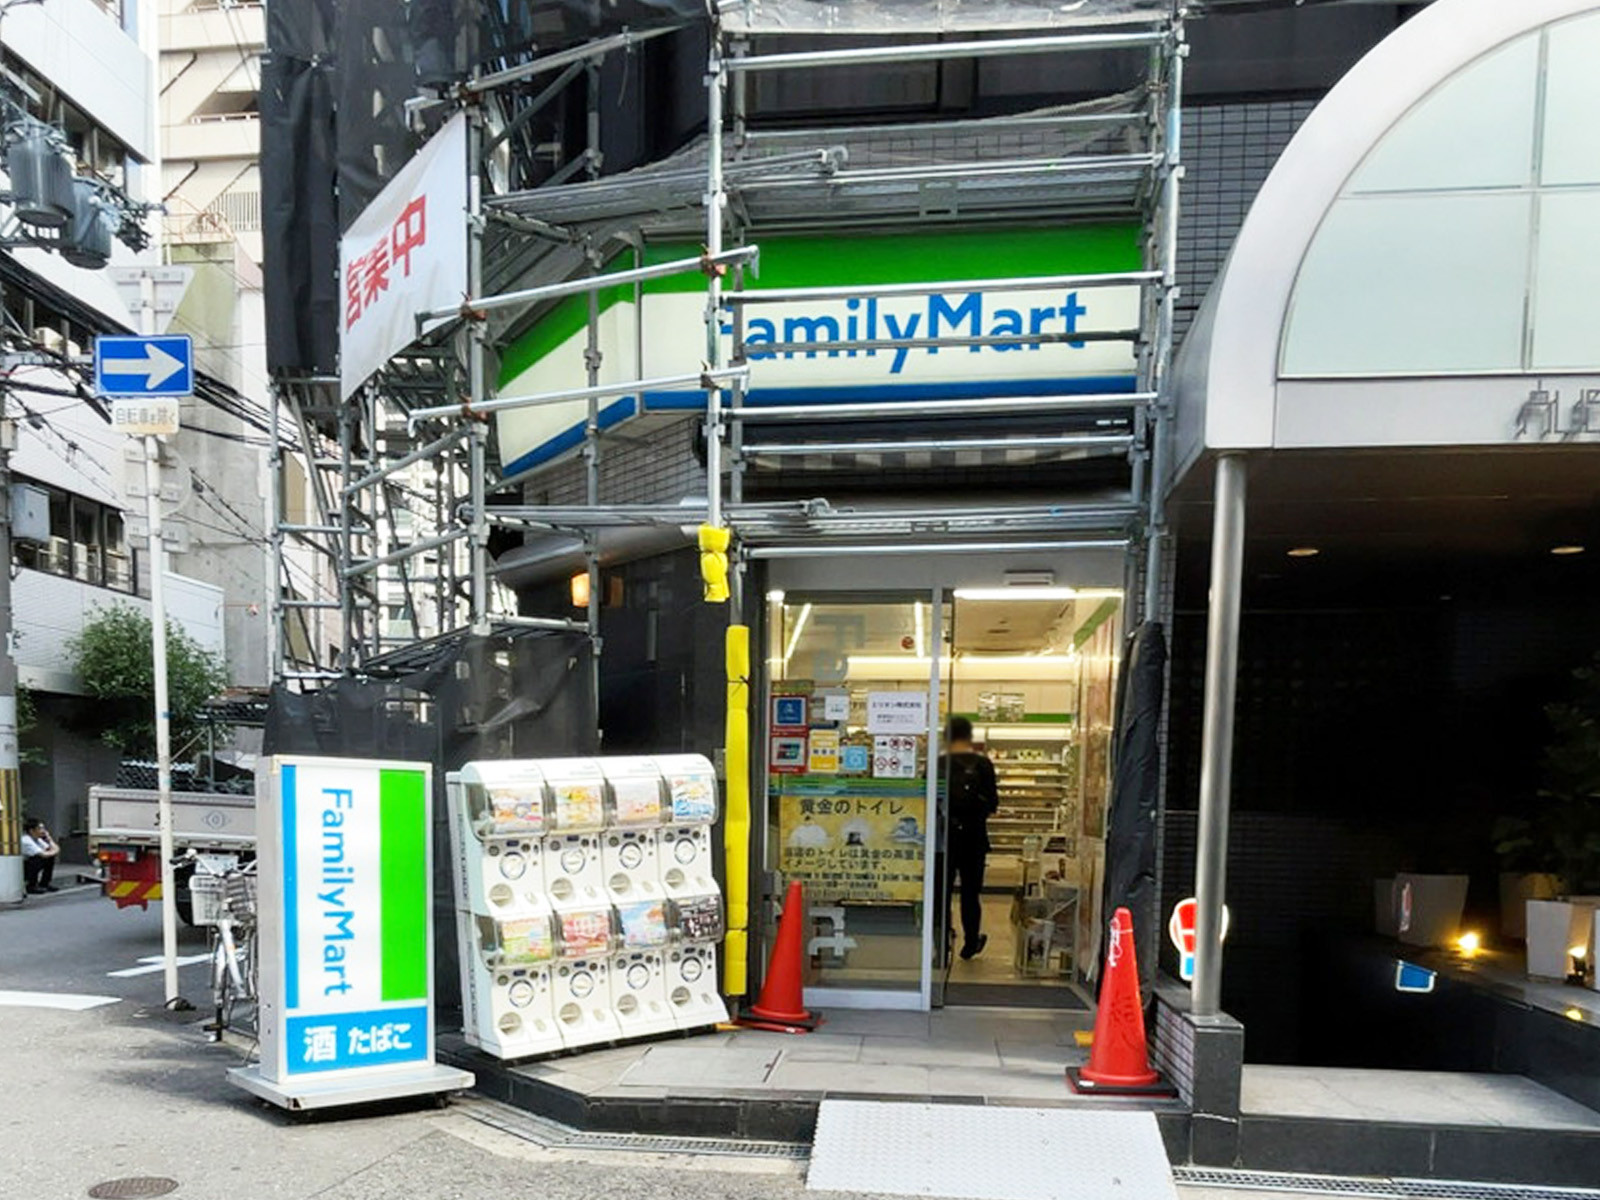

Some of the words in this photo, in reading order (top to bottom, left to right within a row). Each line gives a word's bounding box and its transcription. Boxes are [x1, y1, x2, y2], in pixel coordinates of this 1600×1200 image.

[346, 194, 426, 333] 営業中
[720, 291, 1087, 374] amilyMart
[800, 799, 904, 815] 黄金のトイレ
[317, 788, 355, 996] FamilyMart
[303, 1025, 338, 1063] 酒
[348, 1022, 413, 1055] たばこ
